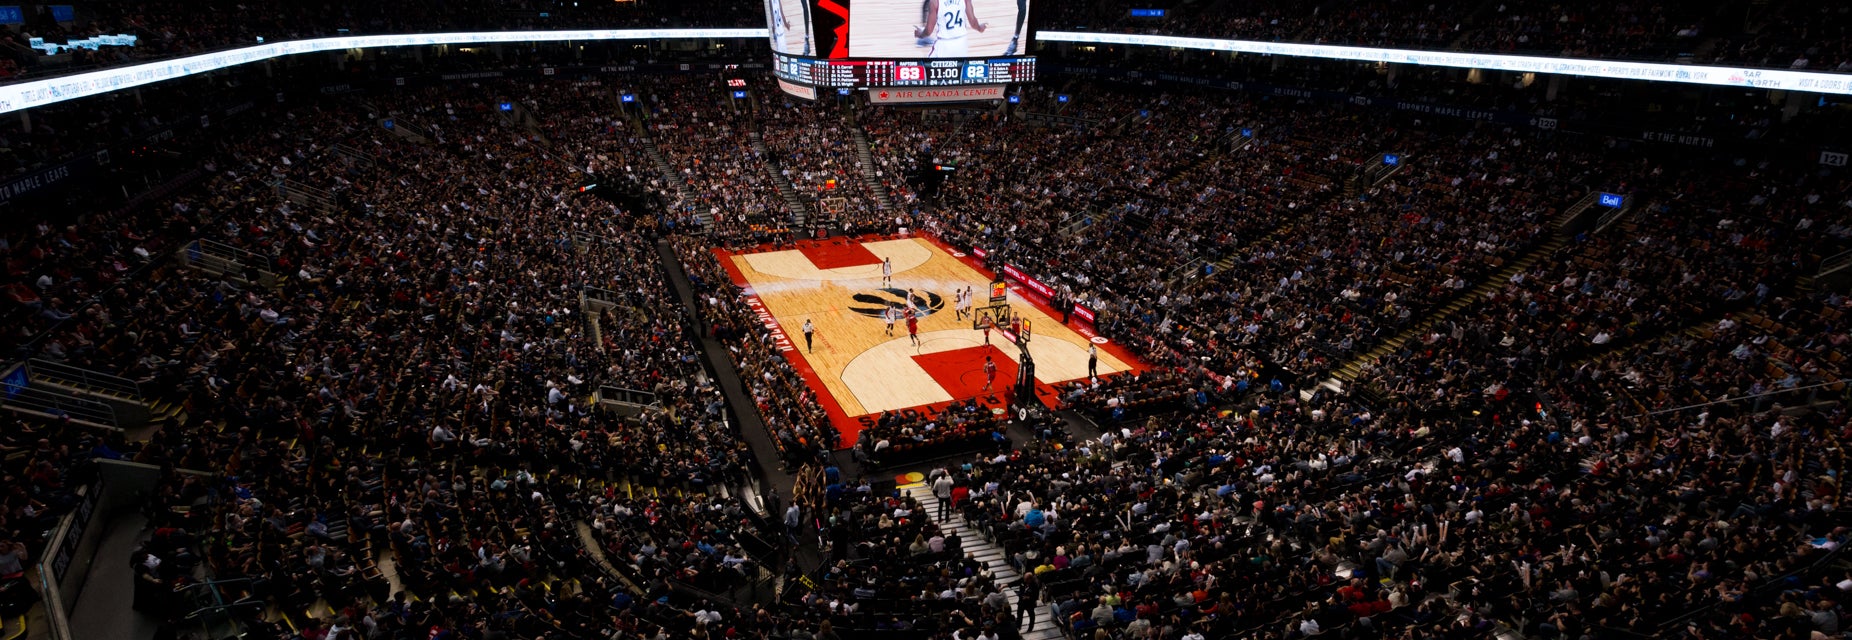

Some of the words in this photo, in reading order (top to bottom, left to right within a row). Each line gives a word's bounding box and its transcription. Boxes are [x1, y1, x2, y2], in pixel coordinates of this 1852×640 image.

[944, 10, 963, 30] 24
[931, 60, 958, 68] CITIZEN
[899, 67, 920, 79] 63
[930, 68, 958, 78] 11:00
[967, 66, 985, 78] 82
[1675, 70, 1691, 80] ROYAL
[1692, 71, 1708, 80] YORK
[1743, 69, 1761, 78] BAR
[1798, 77, 1813, 88] VISIT
[1820, 79, 1841, 89] COORS
[918, 89, 959, 98] CANADA
[963, 88, 998, 97] CENTRE
[1396, 101, 1430, 113] TORONTO
[1435, 106, 1461, 117] MAPLE
[1466, 110, 1493, 121] LEAFS
[1540, 119, 1555, 128] 120
[1643, 131, 1655, 140] WE
[1657, 132, 1676, 143] THE
[1678, 135, 1714, 148] NORTH
[1385, 154, 1397, 164] Bell
[1824, 154, 1844, 165] 121
[13, 175, 41, 195] MAPLE
[44, 165, 69, 183] LEAFS
[1603, 195, 1619, 206] Bell
[754, 307, 772, 322] THE
[765, 323, 794, 352] NORTH
